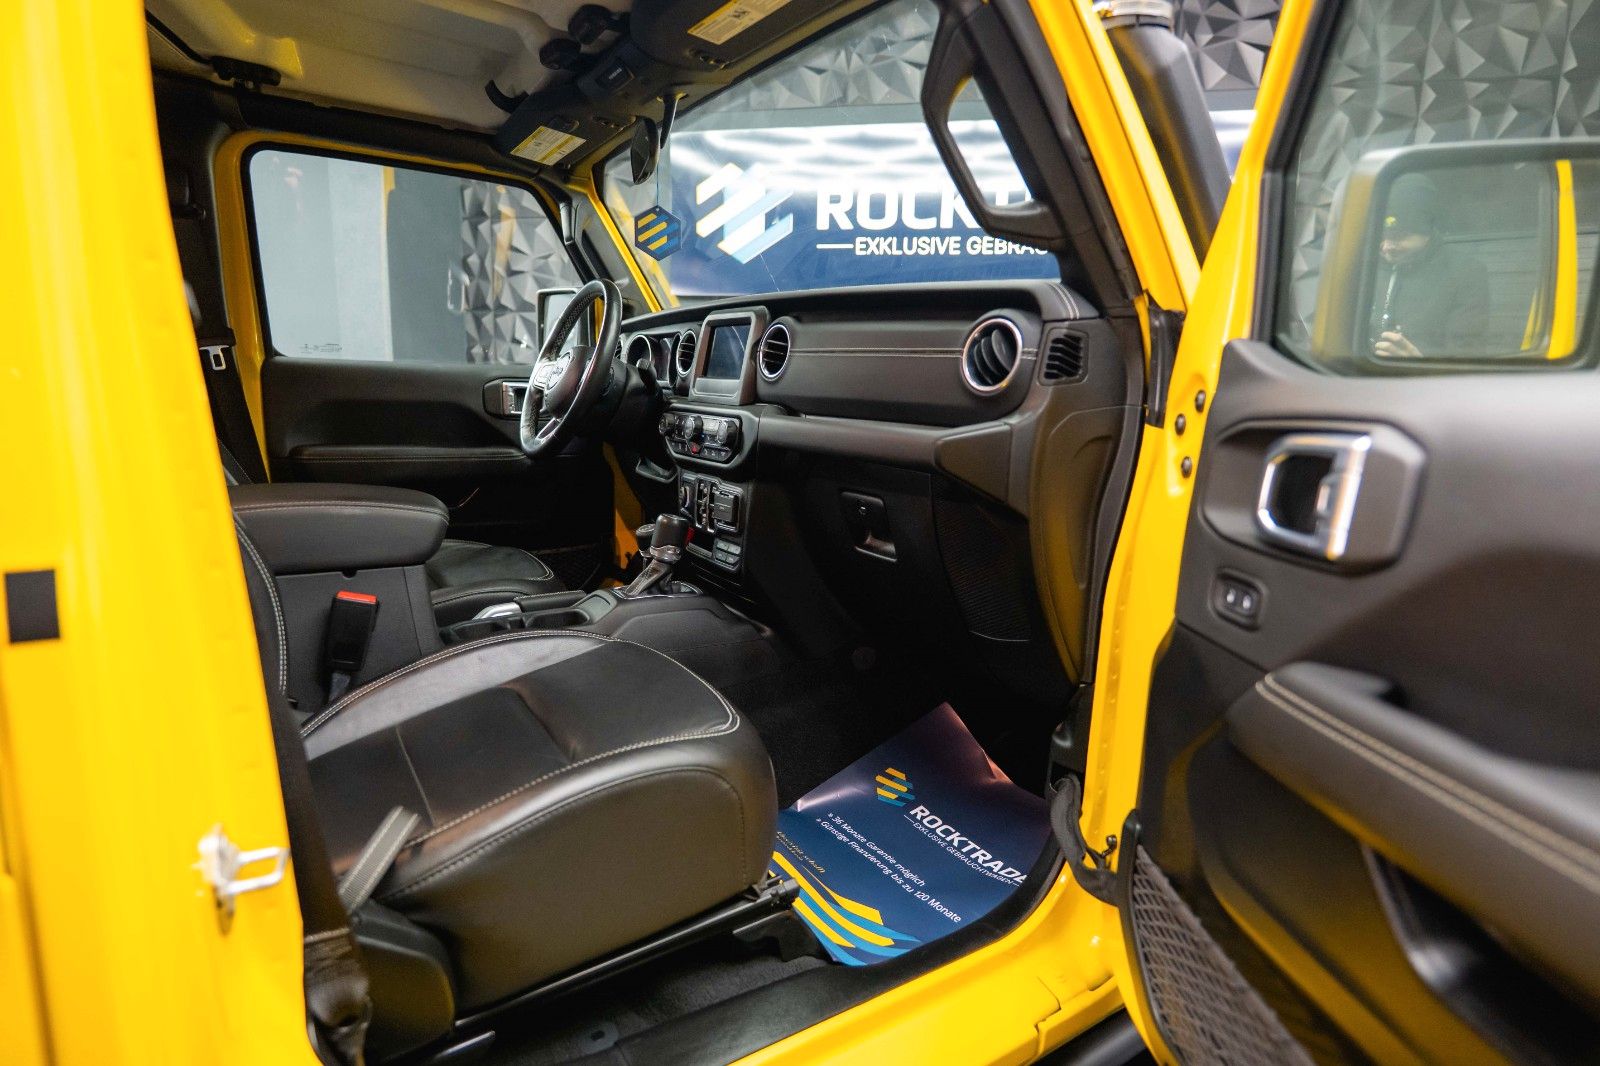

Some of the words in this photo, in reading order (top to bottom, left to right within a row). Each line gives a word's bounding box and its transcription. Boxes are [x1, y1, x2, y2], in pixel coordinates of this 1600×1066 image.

[816, 182, 1032, 230] ROCKT
[855, 236, 961, 255] EXKLUSIVE
[821, 821, 850, 843] Günstige
[848, 841, 892, 875] Finanzierung
[891, 873, 904, 885] bis
[902, 883, 915, 893] zu
[914, 890, 930, 901] 120
[928, 898, 962, 923] Monate
[832, 815, 843, 825] 36
[841, 822, 867, 843] Monate
[866, 840, 897, 864] Garantie
[895, 863, 925, 887] möglich
[913, 822, 948, 848] EXKLUSIVE
[946, 846, 1013, 885] GEBRAUCHTWAGEN
